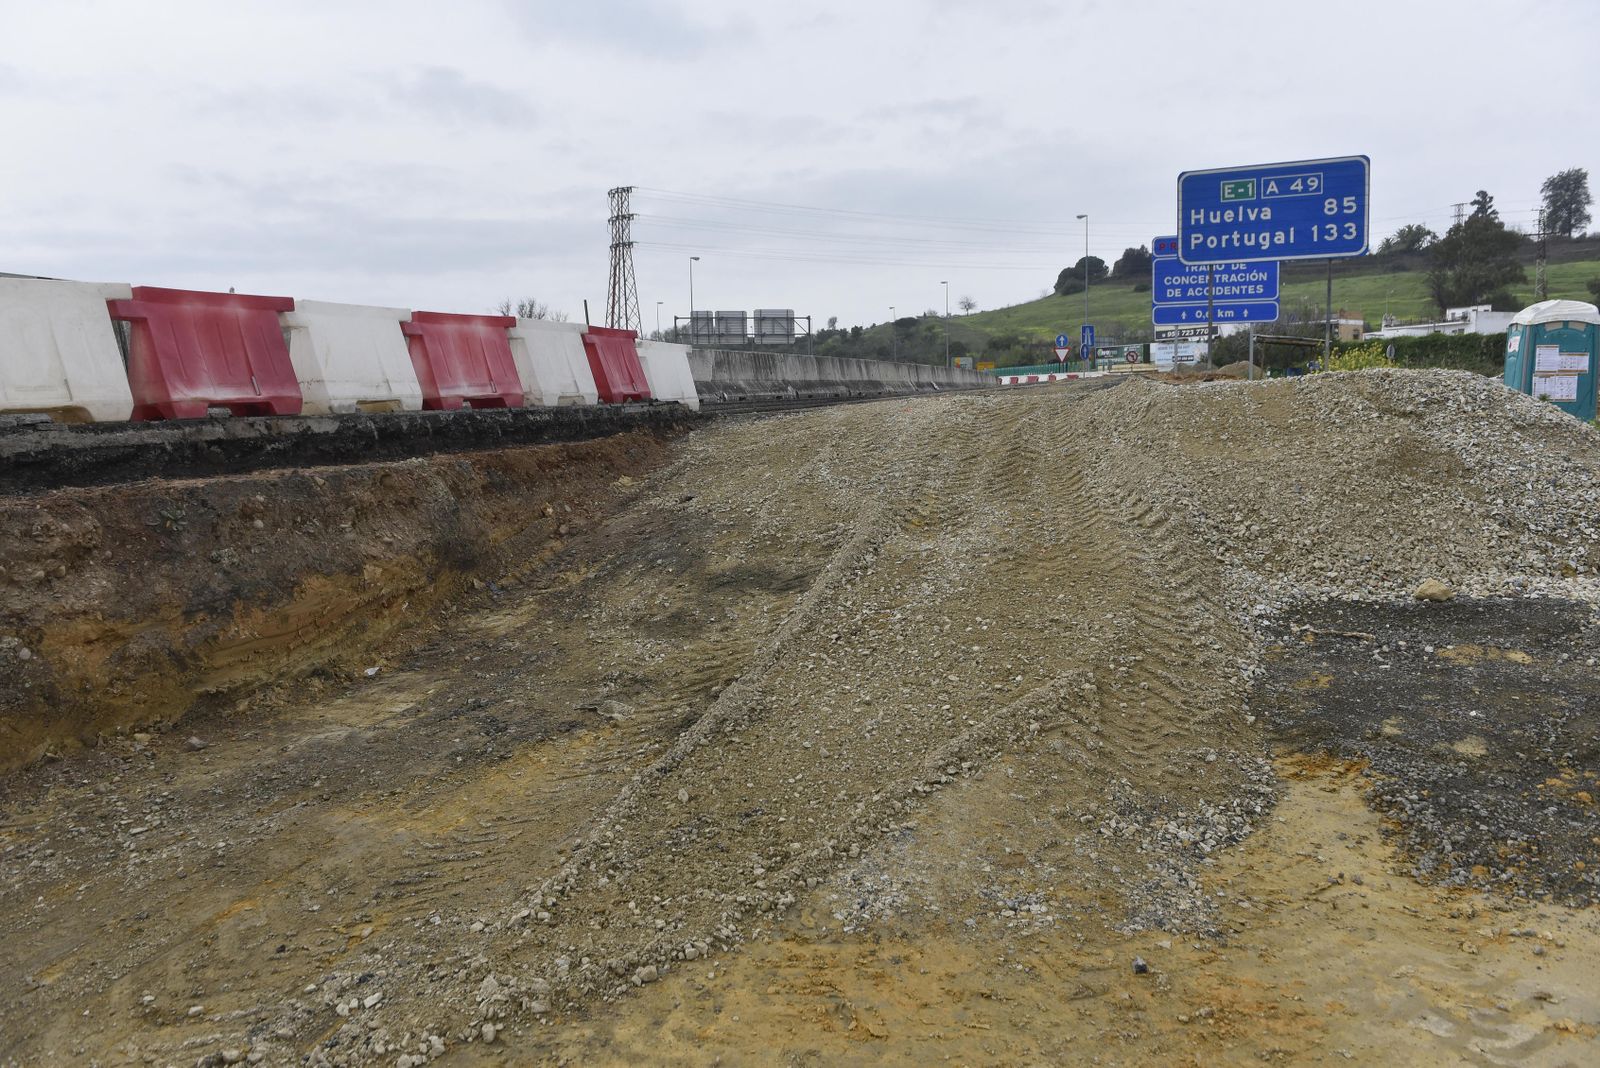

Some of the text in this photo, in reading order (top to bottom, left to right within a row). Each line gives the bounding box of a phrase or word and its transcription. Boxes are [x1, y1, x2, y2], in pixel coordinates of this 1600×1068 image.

[1224, 176, 1319, 198] E-1 A 49
[1190, 196, 1357, 225] Huelva 85
[1190, 222, 1357, 250] Portugal 133
[1166, 284, 1264, 298] DE ACCIDENTES
[1217, 308, 1234, 318] km
